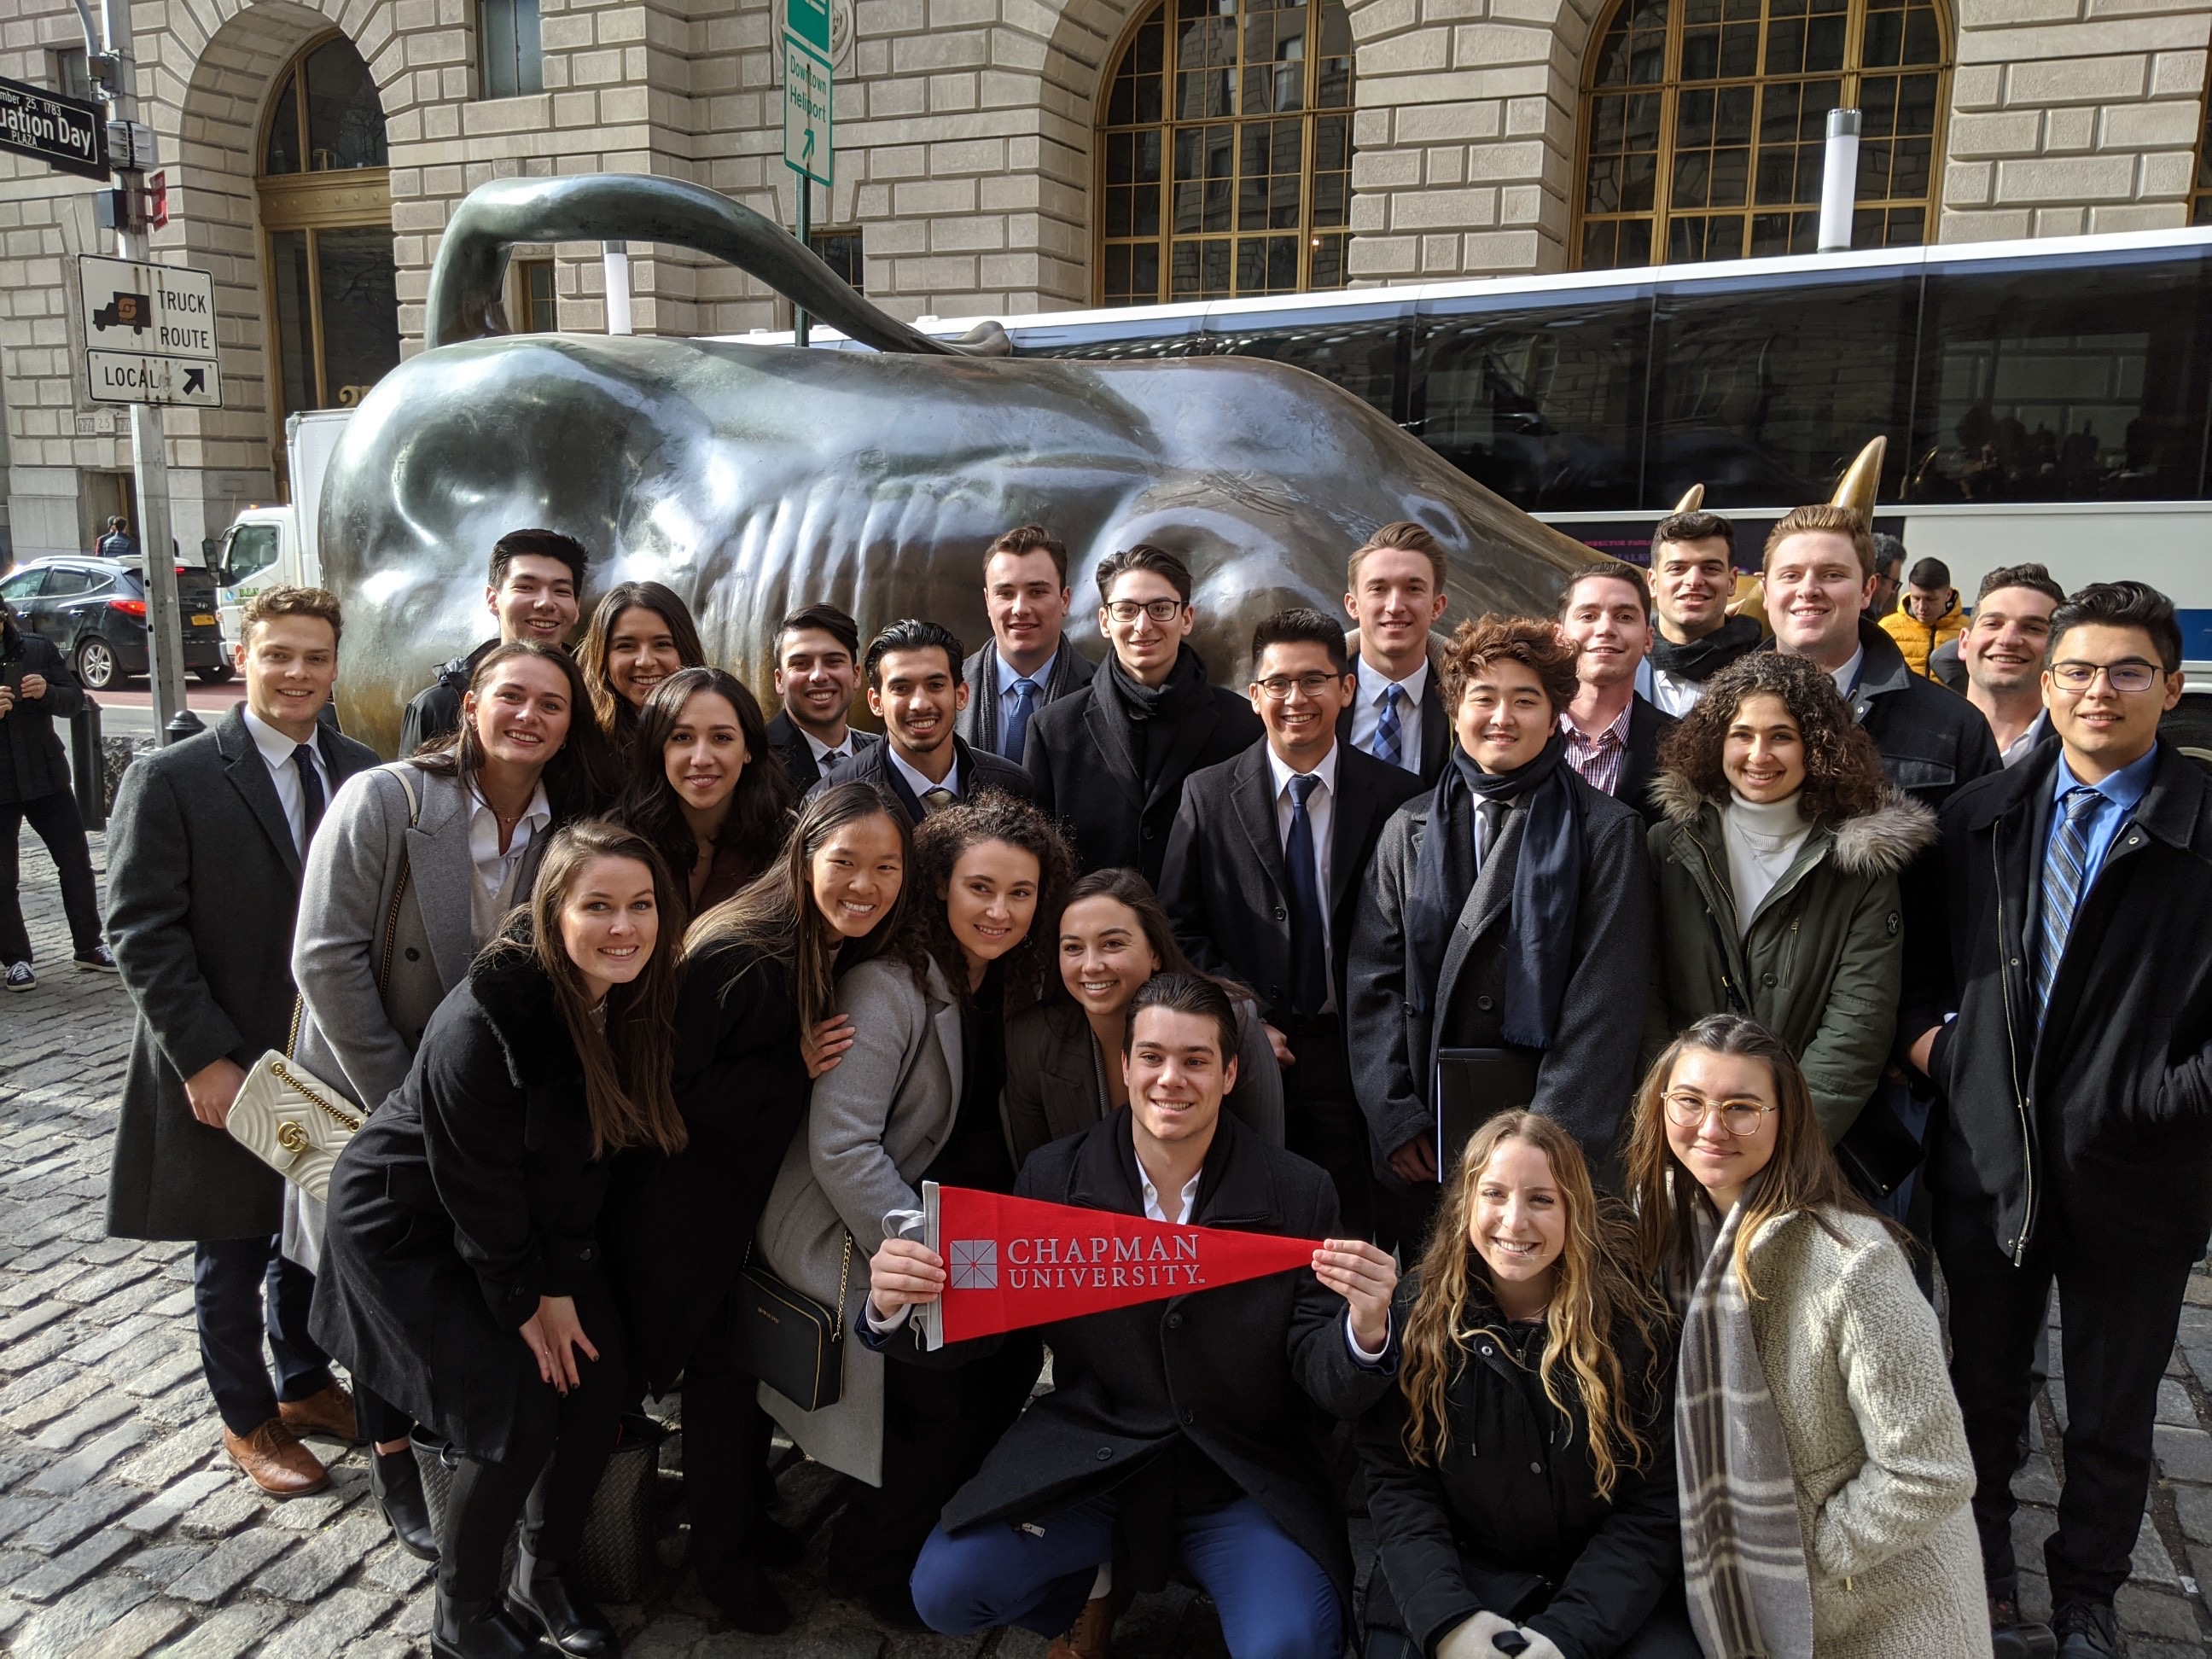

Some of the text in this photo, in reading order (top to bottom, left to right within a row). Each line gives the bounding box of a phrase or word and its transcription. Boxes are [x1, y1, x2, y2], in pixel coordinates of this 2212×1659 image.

[790, 54, 827, 96] Downtown
[44, 102, 62, 117] 1783
[790, 84, 826, 123] Heliport
[12, 130, 38, 148] PLAZA
[57, 116, 91, 156] Day
[157, 289, 207, 314] TRUCK
[160, 326, 210, 349] ROUTE
[104, 365, 160, 389] LOCAL
[98, 417, 110, 429] 25
[1007, 1235, 1199, 1265] CHAPMAN
[1008, 1264, 1201, 1289] UNIVERSITY
